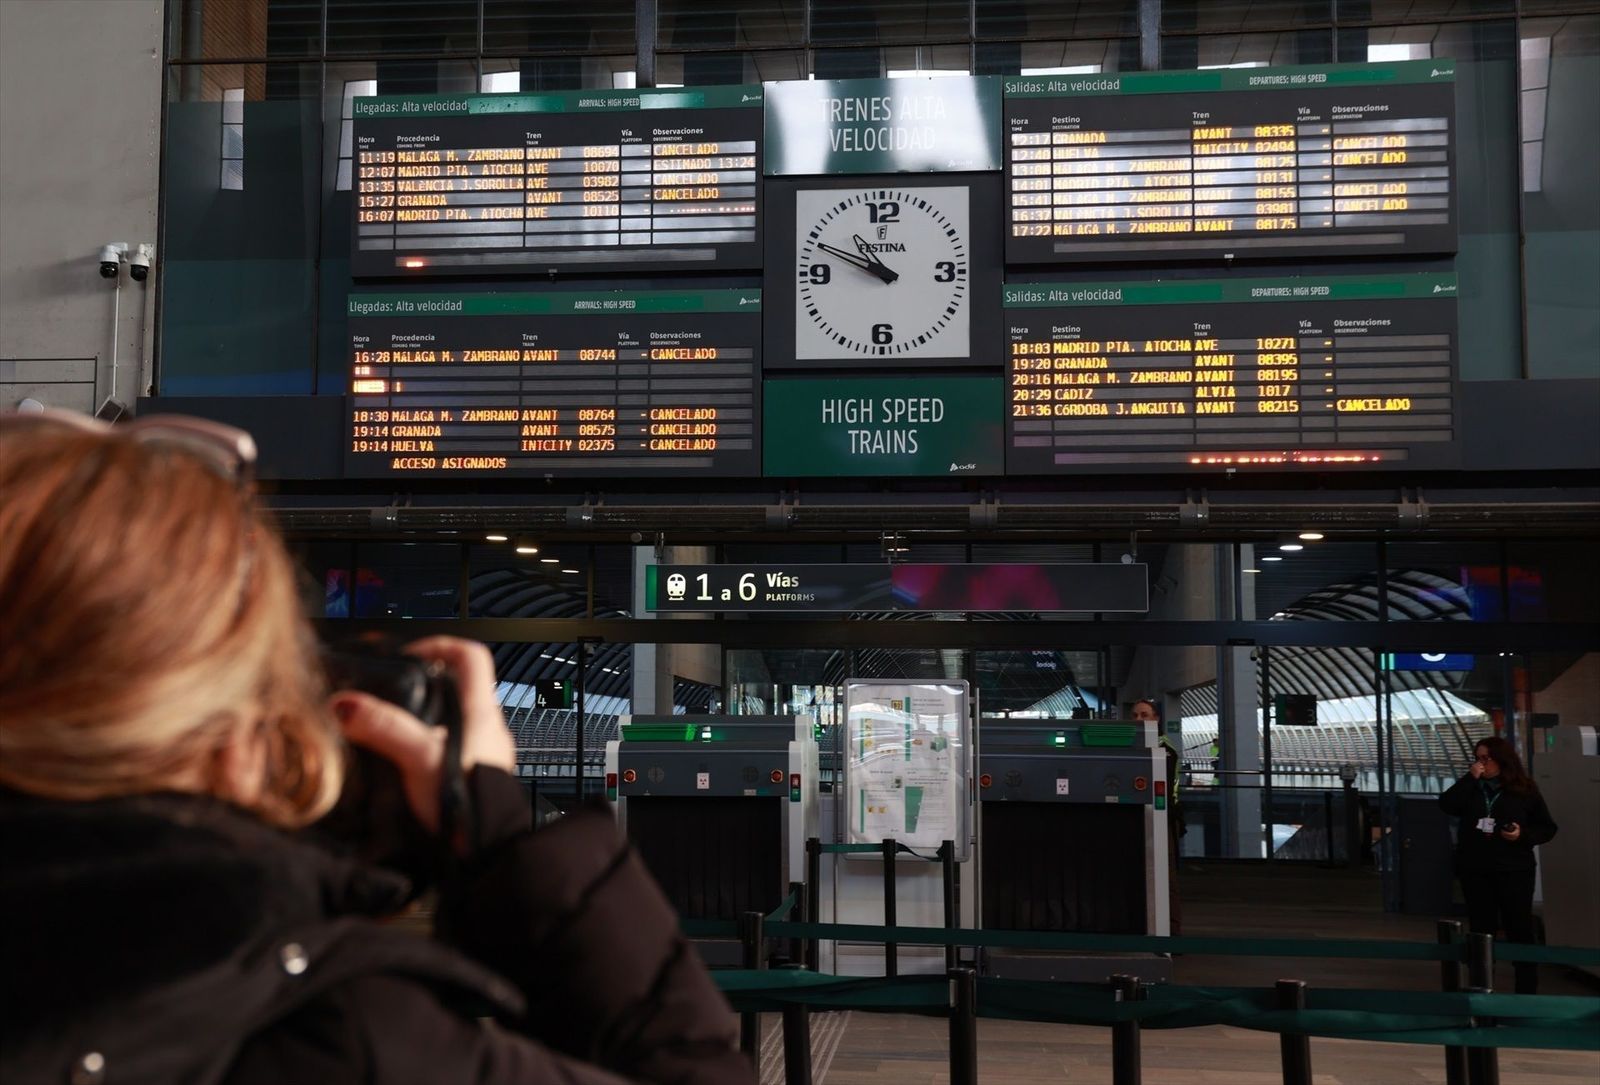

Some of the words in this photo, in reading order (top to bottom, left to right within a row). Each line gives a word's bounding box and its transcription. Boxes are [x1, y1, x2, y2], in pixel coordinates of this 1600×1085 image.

[1006, 82, 1044, 93] Salidas:
[1048, 82, 1067, 92] Alta
[1071, 80, 1119, 91] velocidad
[1250, 76, 1288, 85] DEPARTURES:
[1308, 74, 1326, 83] SPEED
[356, 103, 399, 114] Llegadas:
[402, 102, 420, 112] Alta
[423, 101, 467, 111] velocidad
[579, 99, 606, 107] ARRIVALS:
[623, 98, 639, 106] SPEED
[1332, 104, 1388, 113] Observaciones
[820, 98, 891, 122] TRENES
[900, 98, 946, 119] ALTA
[831, 128, 936, 151] VELOCIDAD
[1054, 132, 1106, 143] GRANADA
[1194, 128, 1232, 139] AVANT
[360, 153, 395, 163] 11:19
[447, 151, 459, 161] M.
[468, 149, 524, 161] ZAMBRANO
[528, 148, 561, 159] AVANT
[655, 144, 719, 155] CANCELADO
[1334, 152, 1406, 165] CANCELADO
[360, 167, 395, 178] 12:07
[398, 166, 440, 176] MADRID
[447, 165, 473, 175] PTA.
[482, 164, 523, 175] ATOCHA
[528, 164, 548, 174] AVE
[655, 158, 711, 170] ESTIMADO
[360, 182, 394, 192] 13:35
[528, 178, 548, 188] AVE
[655, 173, 718, 184] CANCELADO
[1335, 184, 1407, 196] CANCELADO
[360, 196, 394, 207] 15:27
[398, 195, 447, 206] GRANADA
[528, 193, 562, 203] AVANT
[655, 188, 719, 200] CANCELADO
[866, 202, 900, 223] 12
[1336, 200, 1408, 211] CANCELADO
[360, 211, 394, 222] 16:07
[398, 210, 440, 220] MADRID
[447, 209, 472, 219] PTA.
[482, 208, 523, 218] ATOCHA
[528, 207, 548, 218] AVE
[1195, 221, 1233, 231] AVANT
[810, 264, 830, 285] 9
[934, 262, 955, 283] 3
[1006, 291, 1045, 303] Salidas:
[1049, 291, 1068, 301] Alta
[1072, 289, 1121, 301] velocidad
[1252, 287, 1292, 296] DEPARTURES:
[1293, 287, 1309, 296] HIGH
[1311, 286, 1329, 295] SPEED
[350, 301, 393, 314] Llegadas:
[396, 301, 414, 311] Alta
[417, 300, 462, 311] velocidad
[872, 324, 892, 344] 6
[1013, 343, 1050, 354] 18:03
[1054, 342, 1099, 353] MADRID
[1107, 342, 1135, 352] PTA.
[1145, 341, 1191, 351] ATOCHA
[1195, 339, 1218, 350] AVE
[355, 352, 390, 363] 16:28
[443, 351, 454, 362] M.
[464, 351, 519, 362] ZAMBRANO
[524, 350, 558, 360] AVANT
[580, 350, 615, 360] 08744
[651, 349, 716, 360] CANCELADO
[1013, 359, 1050, 369] 19:20
[1054, 358, 1107, 368] GRANADA
[1196, 355, 1234, 366] AVANT
[1013, 374, 1050, 385] 20:16
[1108, 373, 1120, 383] M.
[1131, 372, 1192, 383] ZAMBRANO
[1196, 370, 1234, 381] AVANT
[1014, 389, 1051, 400] 20:29
[1197, 386, 1235, 397] ALVIA
[822, 399, 873, 423] HIGH
[882, 399, 944, 423] SPEED
[1014, 405, 1051, 416] 21:36
[1197, 402, 1234, 412] AVANT
[1338, 398, 1411, 410] CANCELADO
[353, 412, 388, 422] 18:30
[441, 412, 453, 421] M.
[462, 410, 519, 421] ZAMBRANO
[522, 410, 557, 421] AVANT
[579, 410, 615, 421] 08764
[651, 409, 715, 420] CANCELADO
[353, 427, 388, 437] 19:14
[392, 426, 441, 436] GRANADA
[522, 426, 558, 436] AVANT
[579, 425, 615, 436] 08575
[651, 424, 715, 435] CANCELADO
[353, 441, 388, 452] 19:14
[391, 441, 433, 451] HUELVA
[579, 440, 614, 450] 02375
[651, 439, 715, 450] CANCELADO
[848, 430, 918, 453] TRAINS
[393, 458, 435, 468] ACCESO
[442, 458, 506, 468] ASIGNADOS
[767, 571, 799, 587] Vías
[696, 574, 712, 600] 1
[721, 587, 731, 600] a
[739, 573, 756, 600] 6
[537, 694, 546, 707] 4
